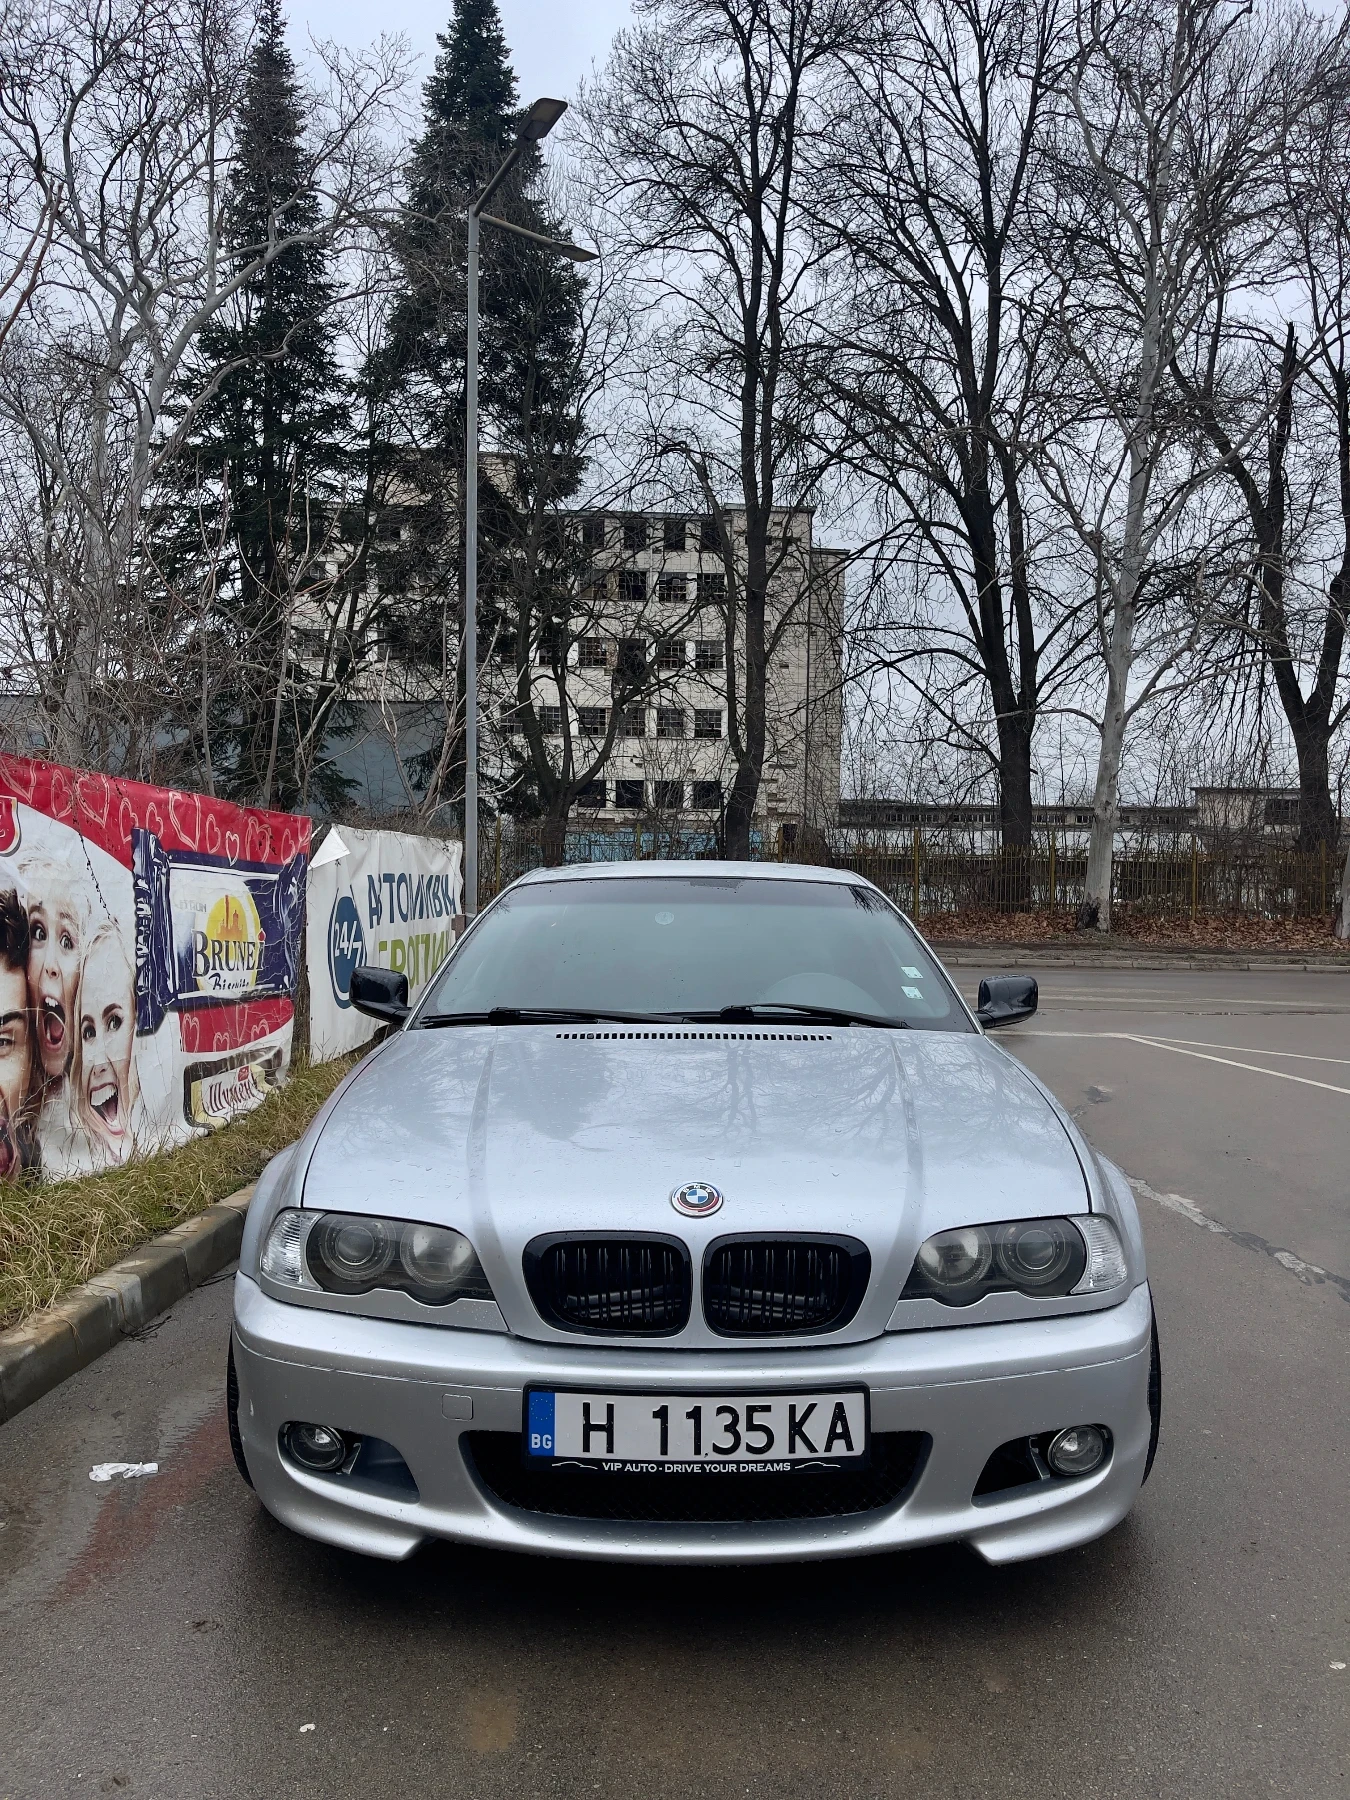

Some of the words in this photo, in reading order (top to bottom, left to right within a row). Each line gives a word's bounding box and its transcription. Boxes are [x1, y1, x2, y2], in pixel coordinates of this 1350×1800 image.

[334, 921, 363, 967] 24/7
[682, 1184, 713, 1193] BMW
[582, 1401, 614, 1453] H
[531, 1433, 552, 1449] BG
[602, 1462, 622, 1472] VIP
[625, 1462, 658, 1473] AUTO
[664, 1463, 701, 1473] DRIVE
[703, 1462, 738, 1473] YOUR
[739, 1461, 791, 1473] DREAMS
